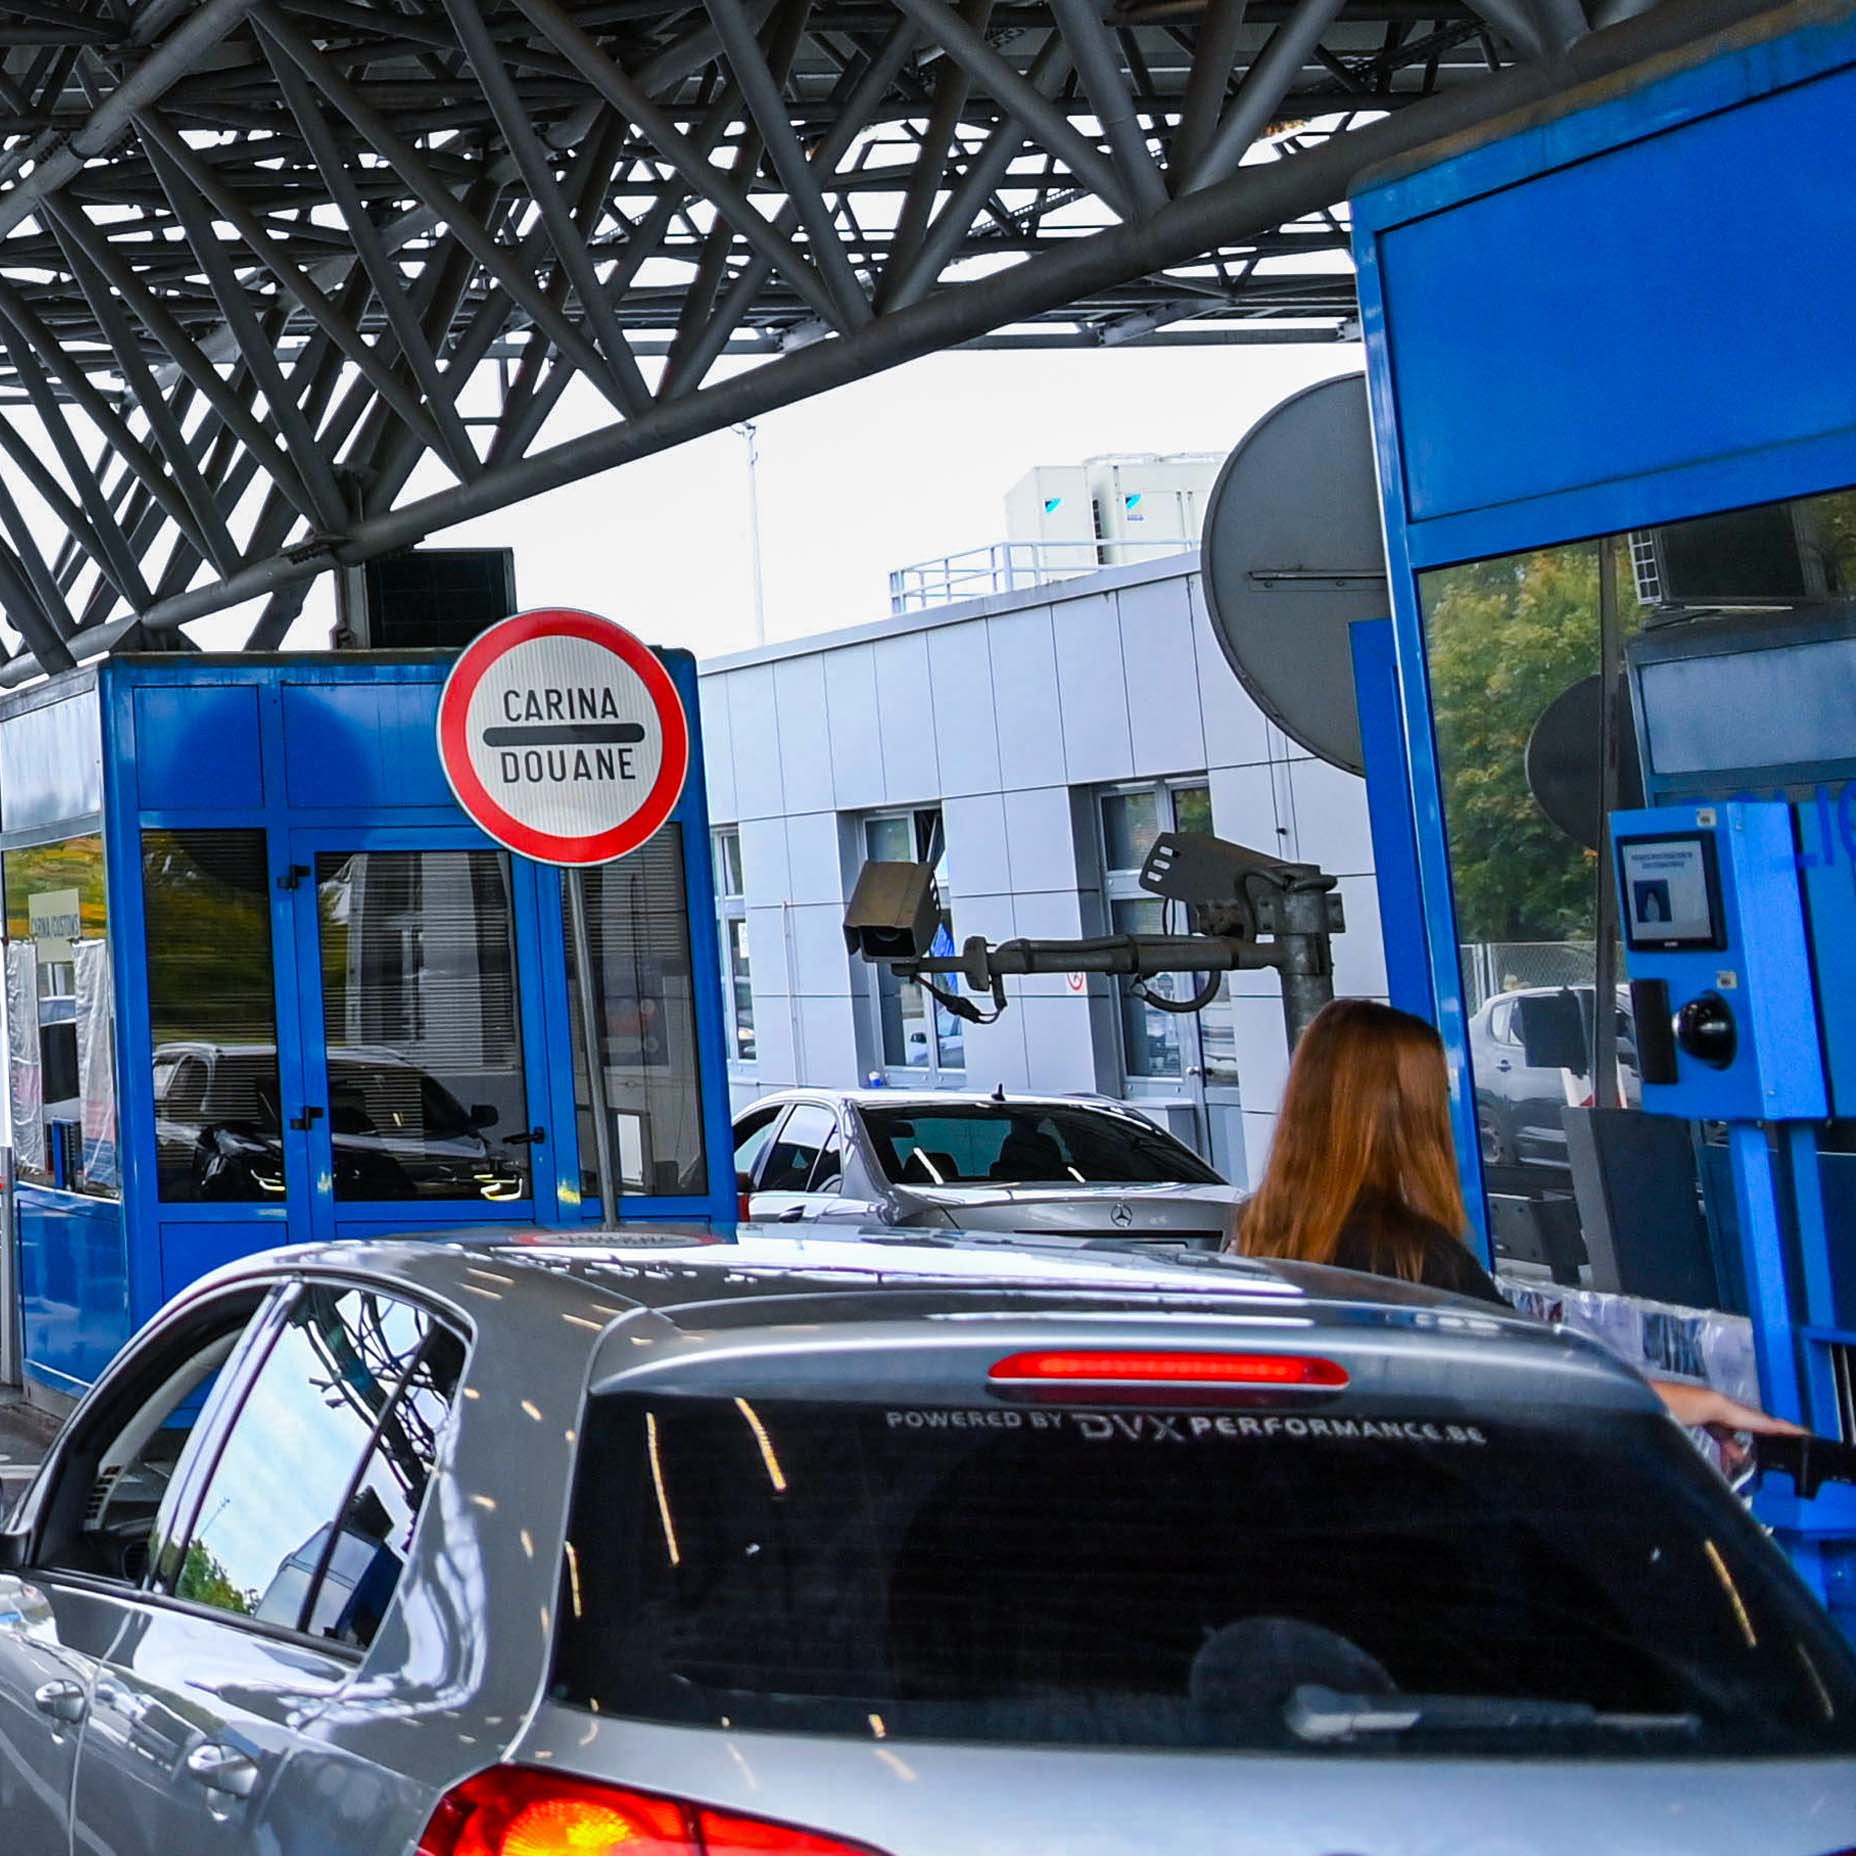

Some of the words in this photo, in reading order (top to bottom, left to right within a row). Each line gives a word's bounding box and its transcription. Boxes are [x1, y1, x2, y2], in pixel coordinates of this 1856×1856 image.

[504, 687, 619, 722] CARINA
[501, 748, 636, 783] DOUANE
[885, 1410, 1022, 1429] POWERED
[1030, 1410, 1065, 1430] BY
[1071, 1412, 1187, 1442] DVX
[1189, 1415, 1488, 1446] PERFORMANCE.BE
